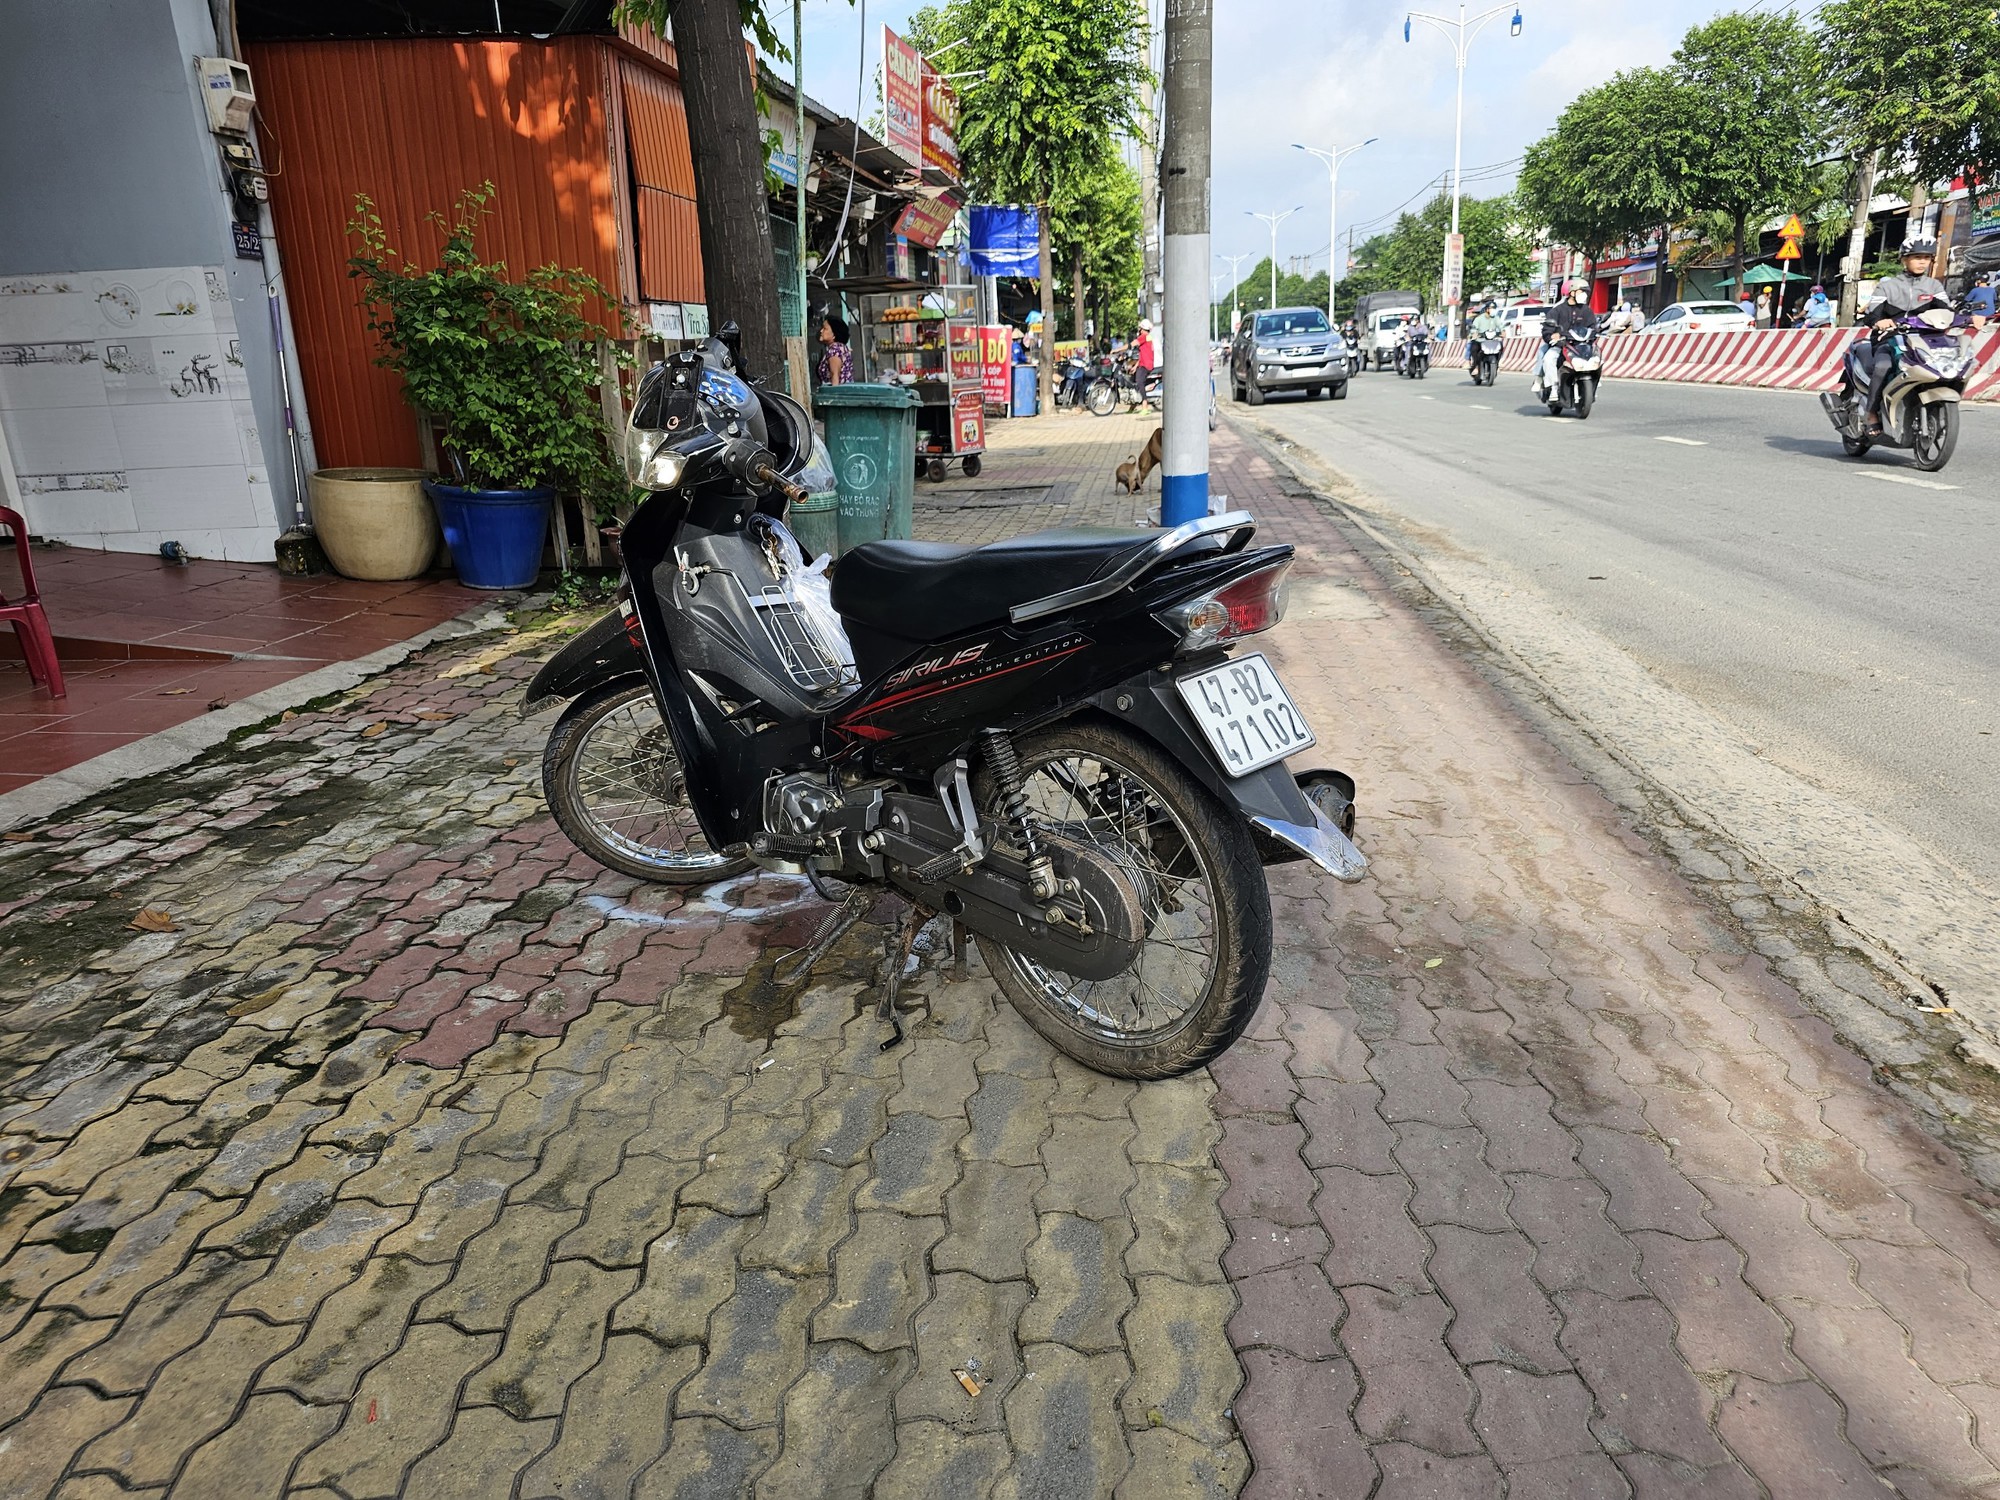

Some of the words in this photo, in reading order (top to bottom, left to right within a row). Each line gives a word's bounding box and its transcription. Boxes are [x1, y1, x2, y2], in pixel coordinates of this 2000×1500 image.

[987, 327, 1007, 364] ĐỒ
[883, 642, 990, 691] SIRIUS
[1216, 703, 1306, 765] 471.02
